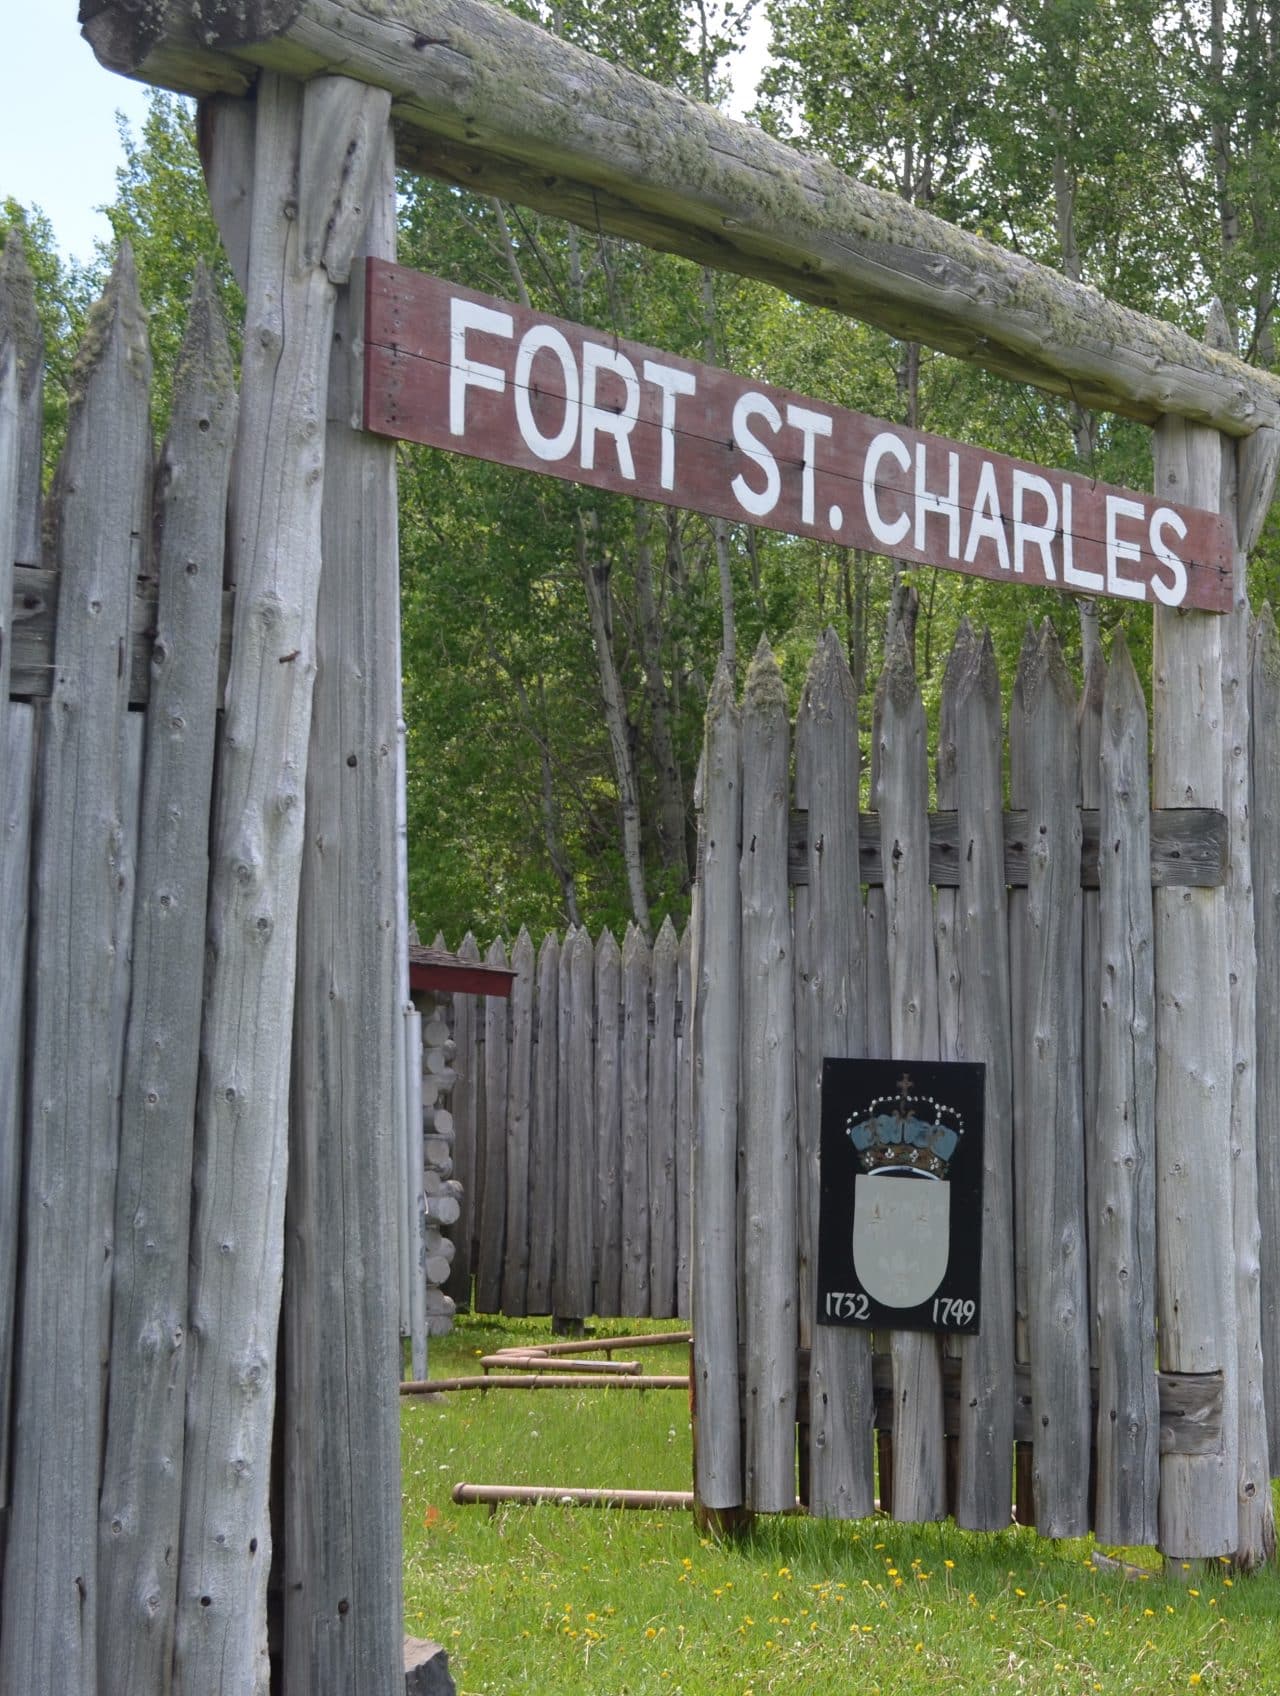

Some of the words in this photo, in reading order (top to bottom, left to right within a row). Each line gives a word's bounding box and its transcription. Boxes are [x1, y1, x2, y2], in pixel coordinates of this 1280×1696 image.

[448, 298, 697, 490] FORT
[731, 391, 843, 532] ST.
[863, 432, 1189, 607] CHARLES
[825, 1292, 871, 1321] 1732
[932, 1298, 975, 1326] 1749
